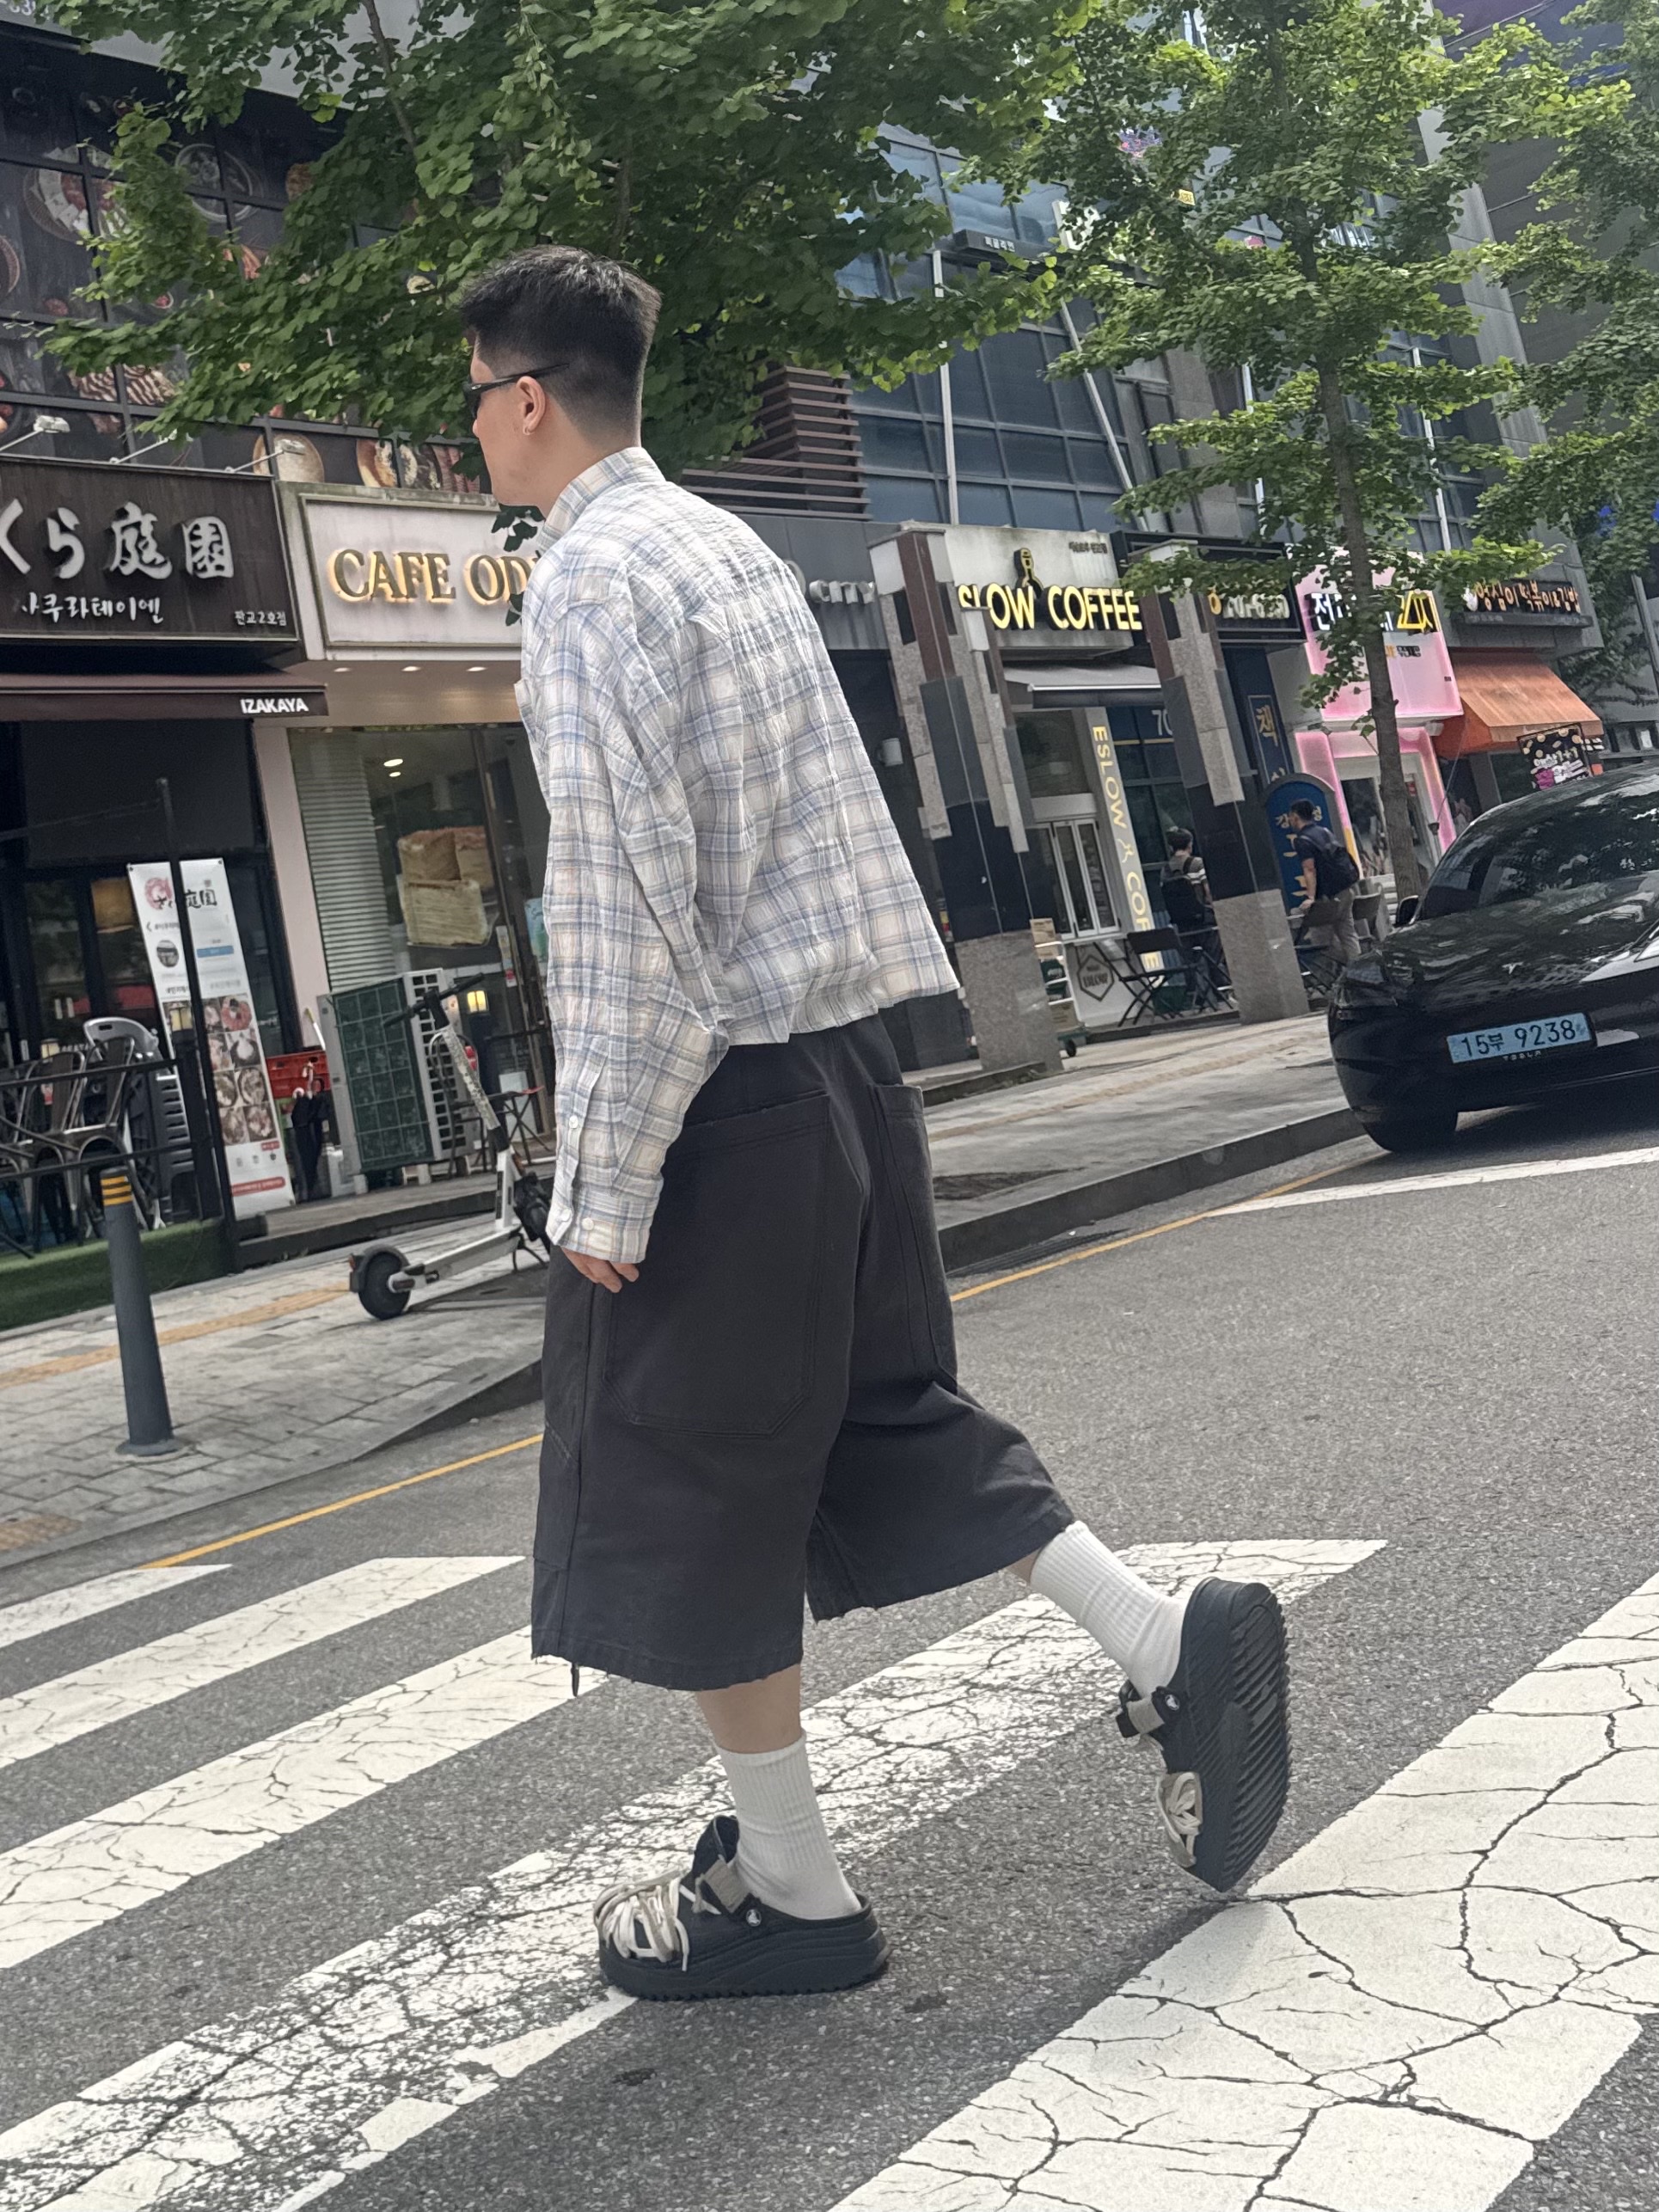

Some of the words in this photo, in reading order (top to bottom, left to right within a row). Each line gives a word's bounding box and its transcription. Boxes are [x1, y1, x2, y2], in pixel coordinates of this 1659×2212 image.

[328, 548, 456, 603] CAFE
[464, 555, 538, 605] OD
[958, 583, 1034, 629] SLOW
[1047, 585, 1143, 630] COFFEE
[240, 698, 309, 714] IZAKAYA
[1514, 1020, 1576, 1048] 9238
